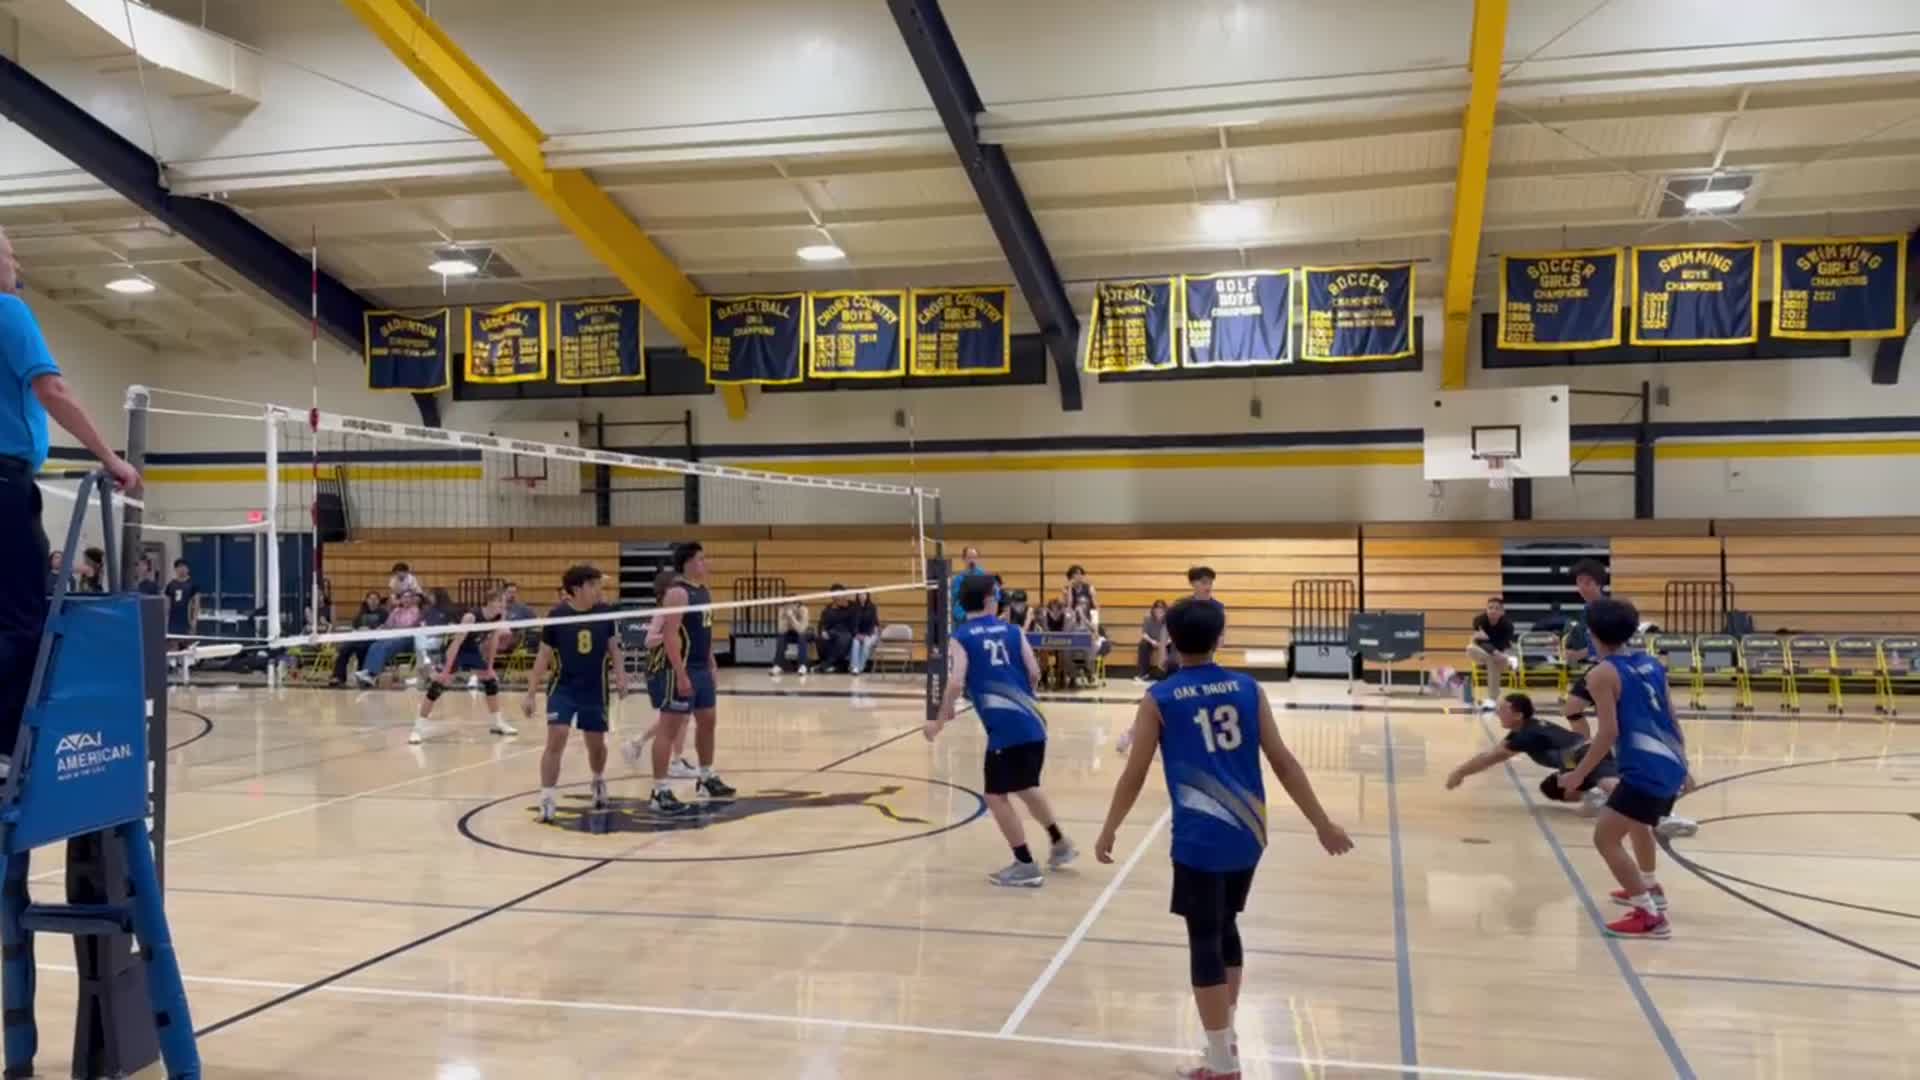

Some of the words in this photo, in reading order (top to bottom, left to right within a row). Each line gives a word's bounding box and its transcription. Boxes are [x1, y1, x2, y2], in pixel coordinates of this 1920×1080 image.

[1658, 250, 1732, 273] SWIMMING
[1796, 244, 1882, 271] SWIMMING
[1818, 261, 1859, 275] GIRLS
[1527, 259, 1597, 279] SOCCER
[1215, 276, 1257, 292] GOLF
[1327, 272, 1389, 296] SOCCER
[1540, 274, 1581, 288] GIRLS
[1533, 288, 1589, 300] CHAMPIONS
[717, 300, 791, 320] BASKETBALL
[577, 629, 592, 654] 8
[983, 639, 1011, 667] 21
[1173, 684, 1199, 700] OAK
[1192, 703, 1243, 754] 13
[57, 743, 133, 772] AMERICAN
